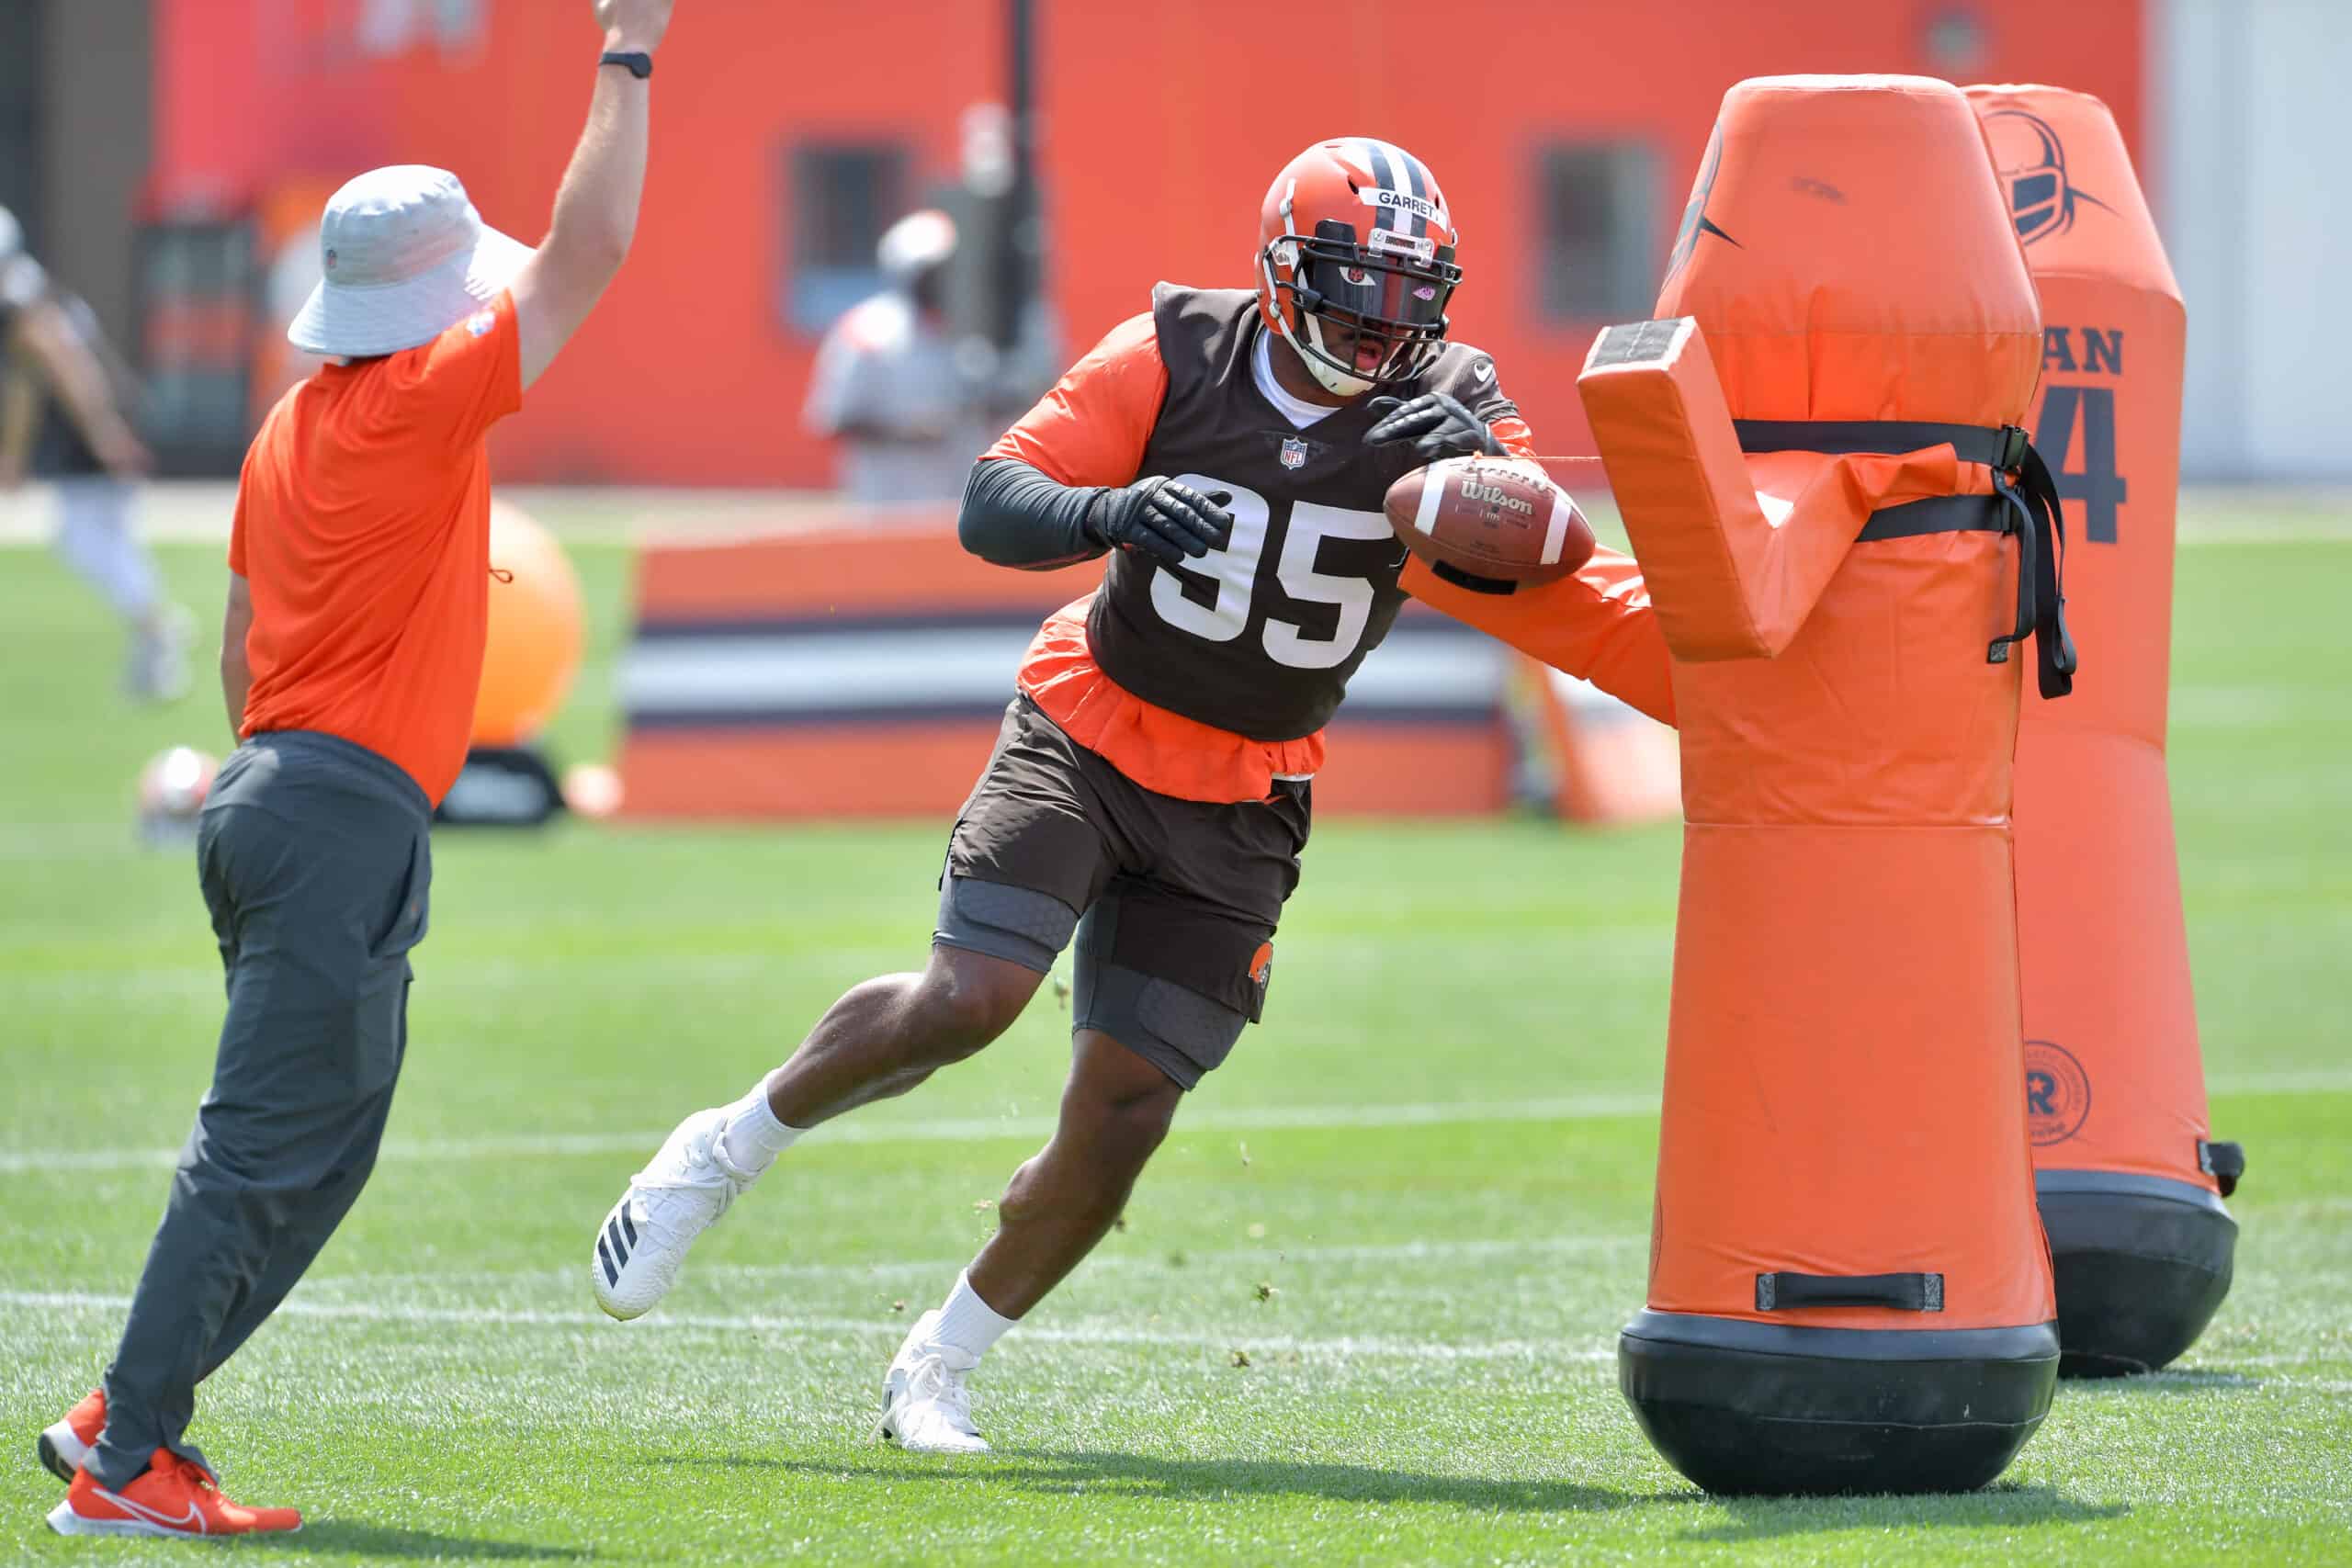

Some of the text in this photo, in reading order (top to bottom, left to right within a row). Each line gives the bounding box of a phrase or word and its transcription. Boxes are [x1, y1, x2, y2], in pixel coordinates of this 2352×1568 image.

[1284, 450, 1302, 464] NFL
[1461, 479, 1533, 515] Wilson
[1149, 473, 1395, 670] 95
